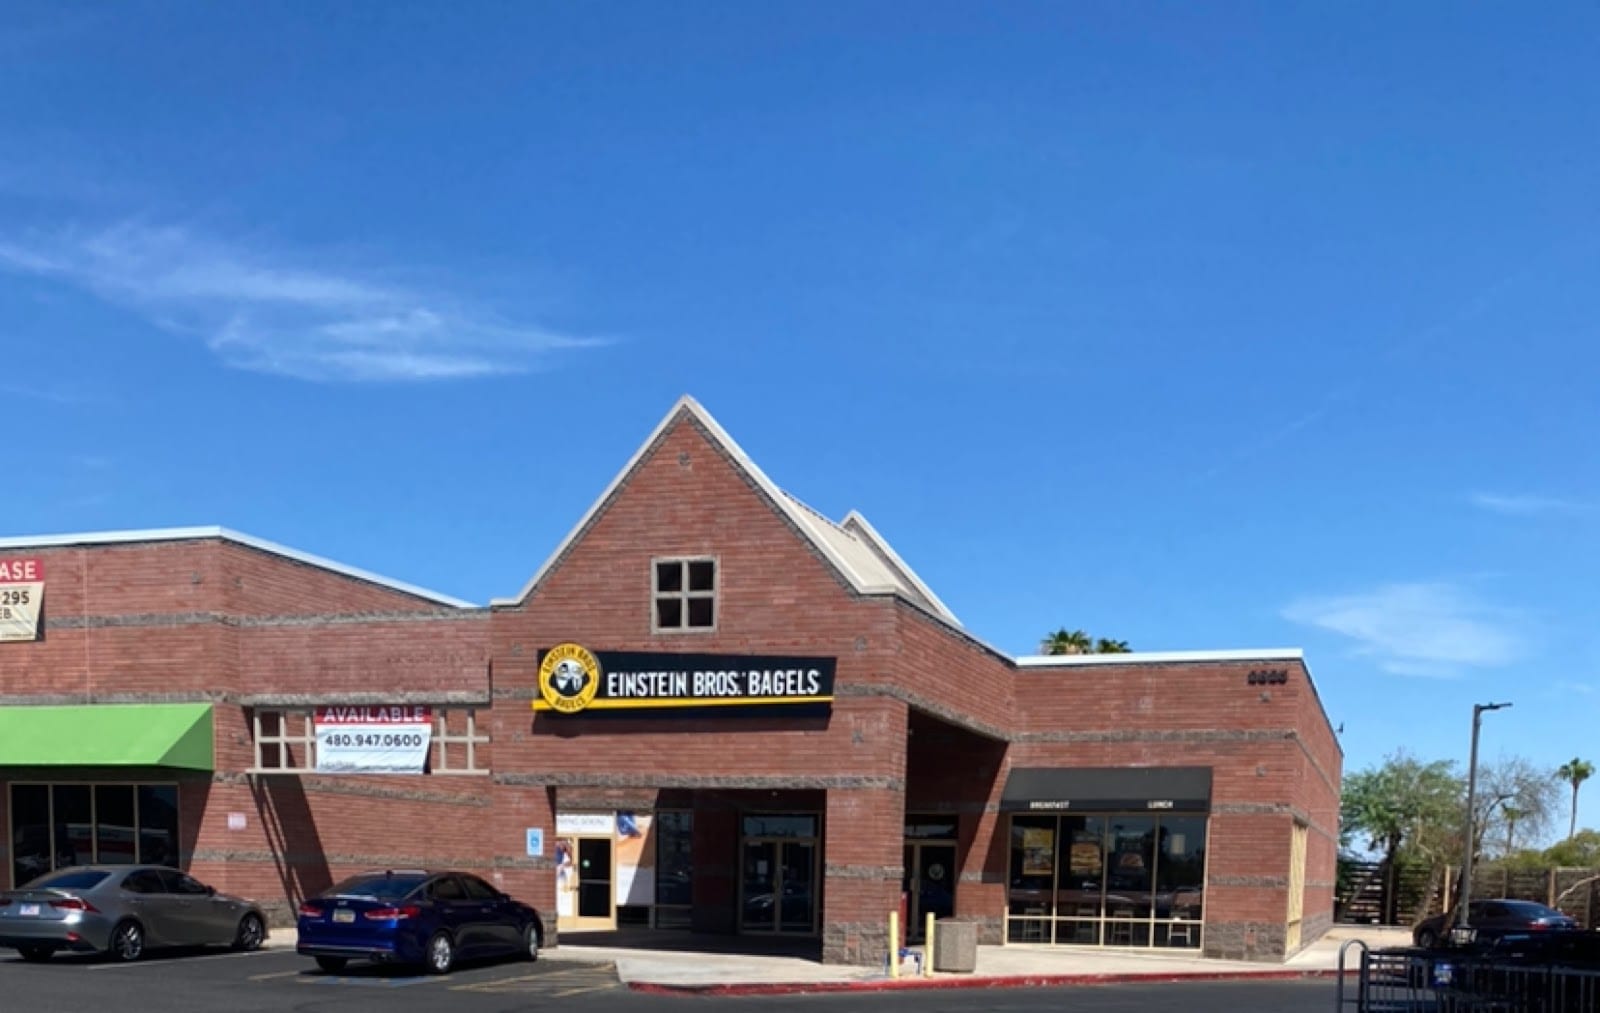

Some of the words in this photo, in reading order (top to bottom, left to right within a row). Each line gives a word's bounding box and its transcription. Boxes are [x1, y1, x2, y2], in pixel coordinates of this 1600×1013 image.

[607, 672, 687, 697] EINSTEIN
[749, 670, 821, 695] BAGELS
[323, 706, 424, 722] AVAILABLE
[325, 734, 422, 746] 480.947.0600
